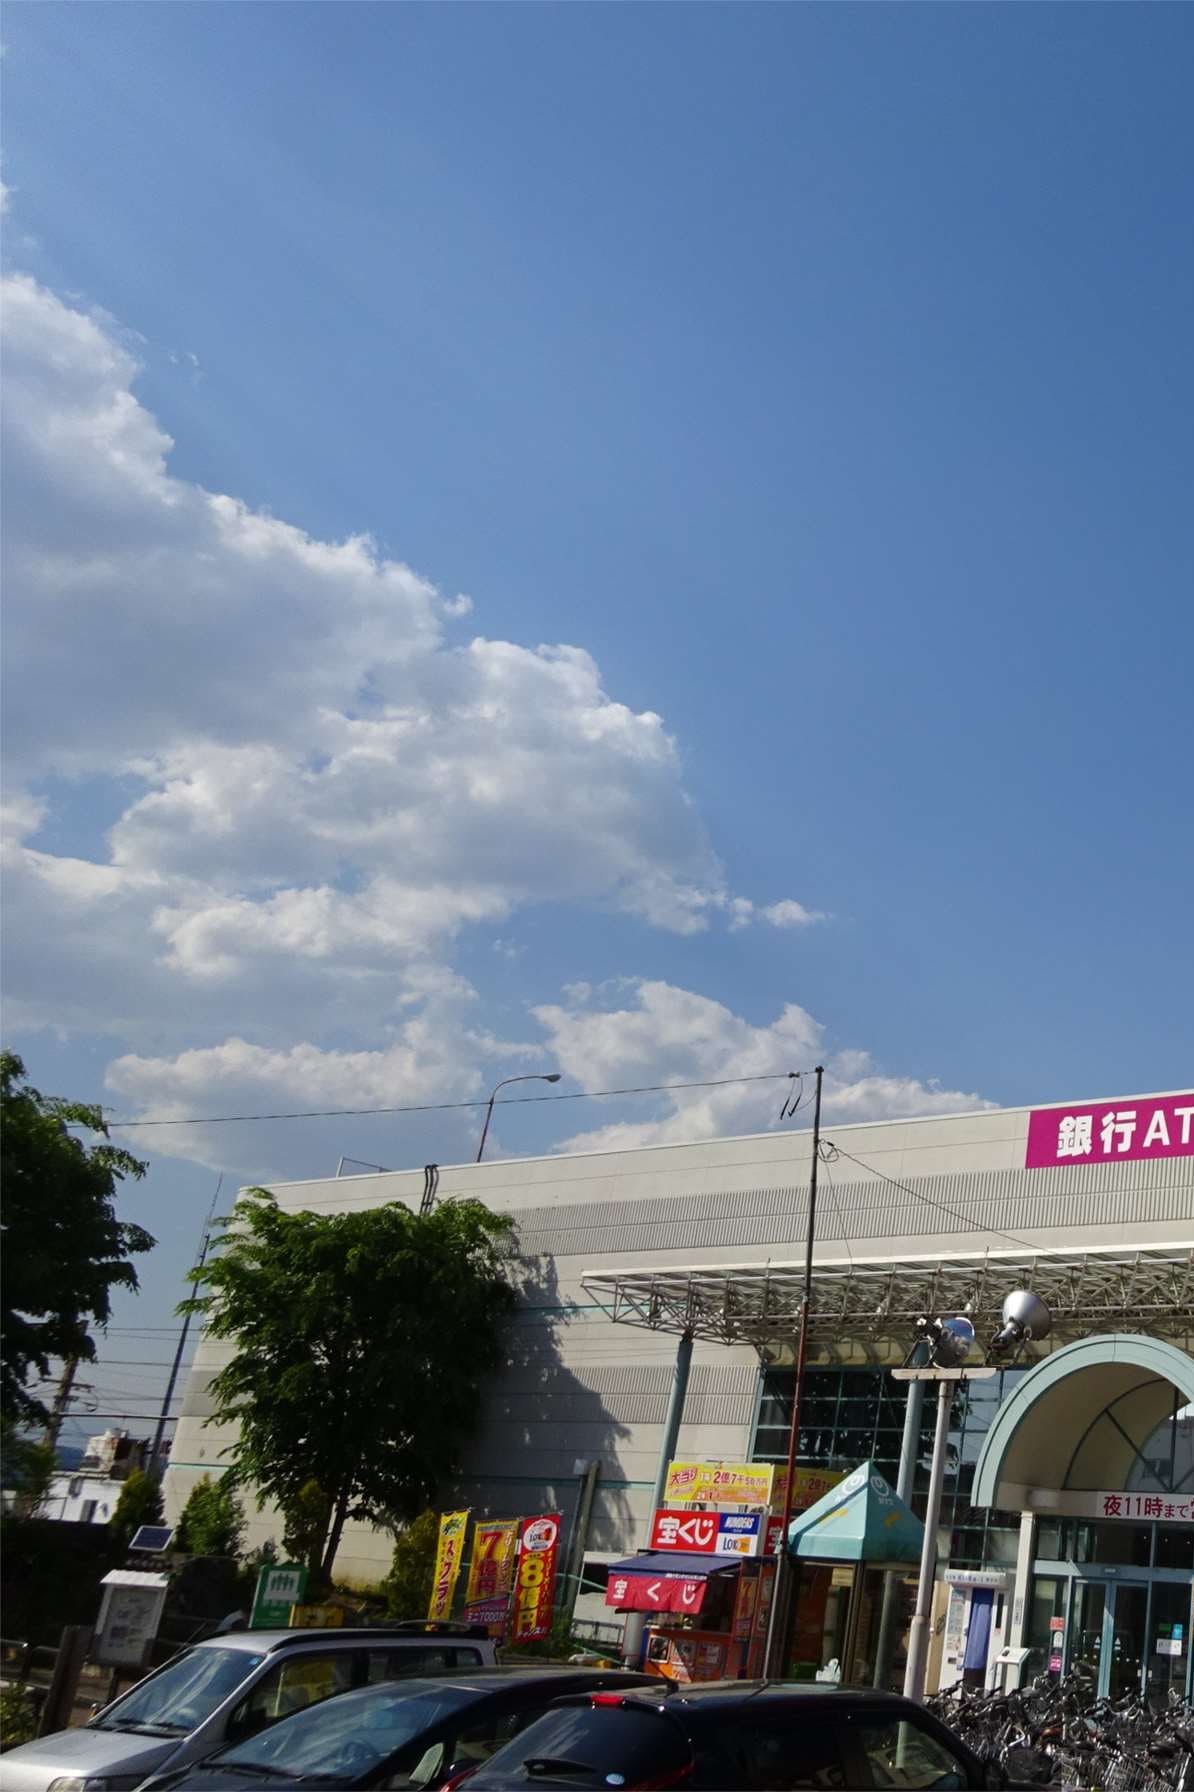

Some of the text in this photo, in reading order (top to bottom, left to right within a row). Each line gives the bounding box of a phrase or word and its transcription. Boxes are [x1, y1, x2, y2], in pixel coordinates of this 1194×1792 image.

[657, 1516, 714, 1545] 宝くじ
[613, 1579, 696, 1605] 宝くじ
